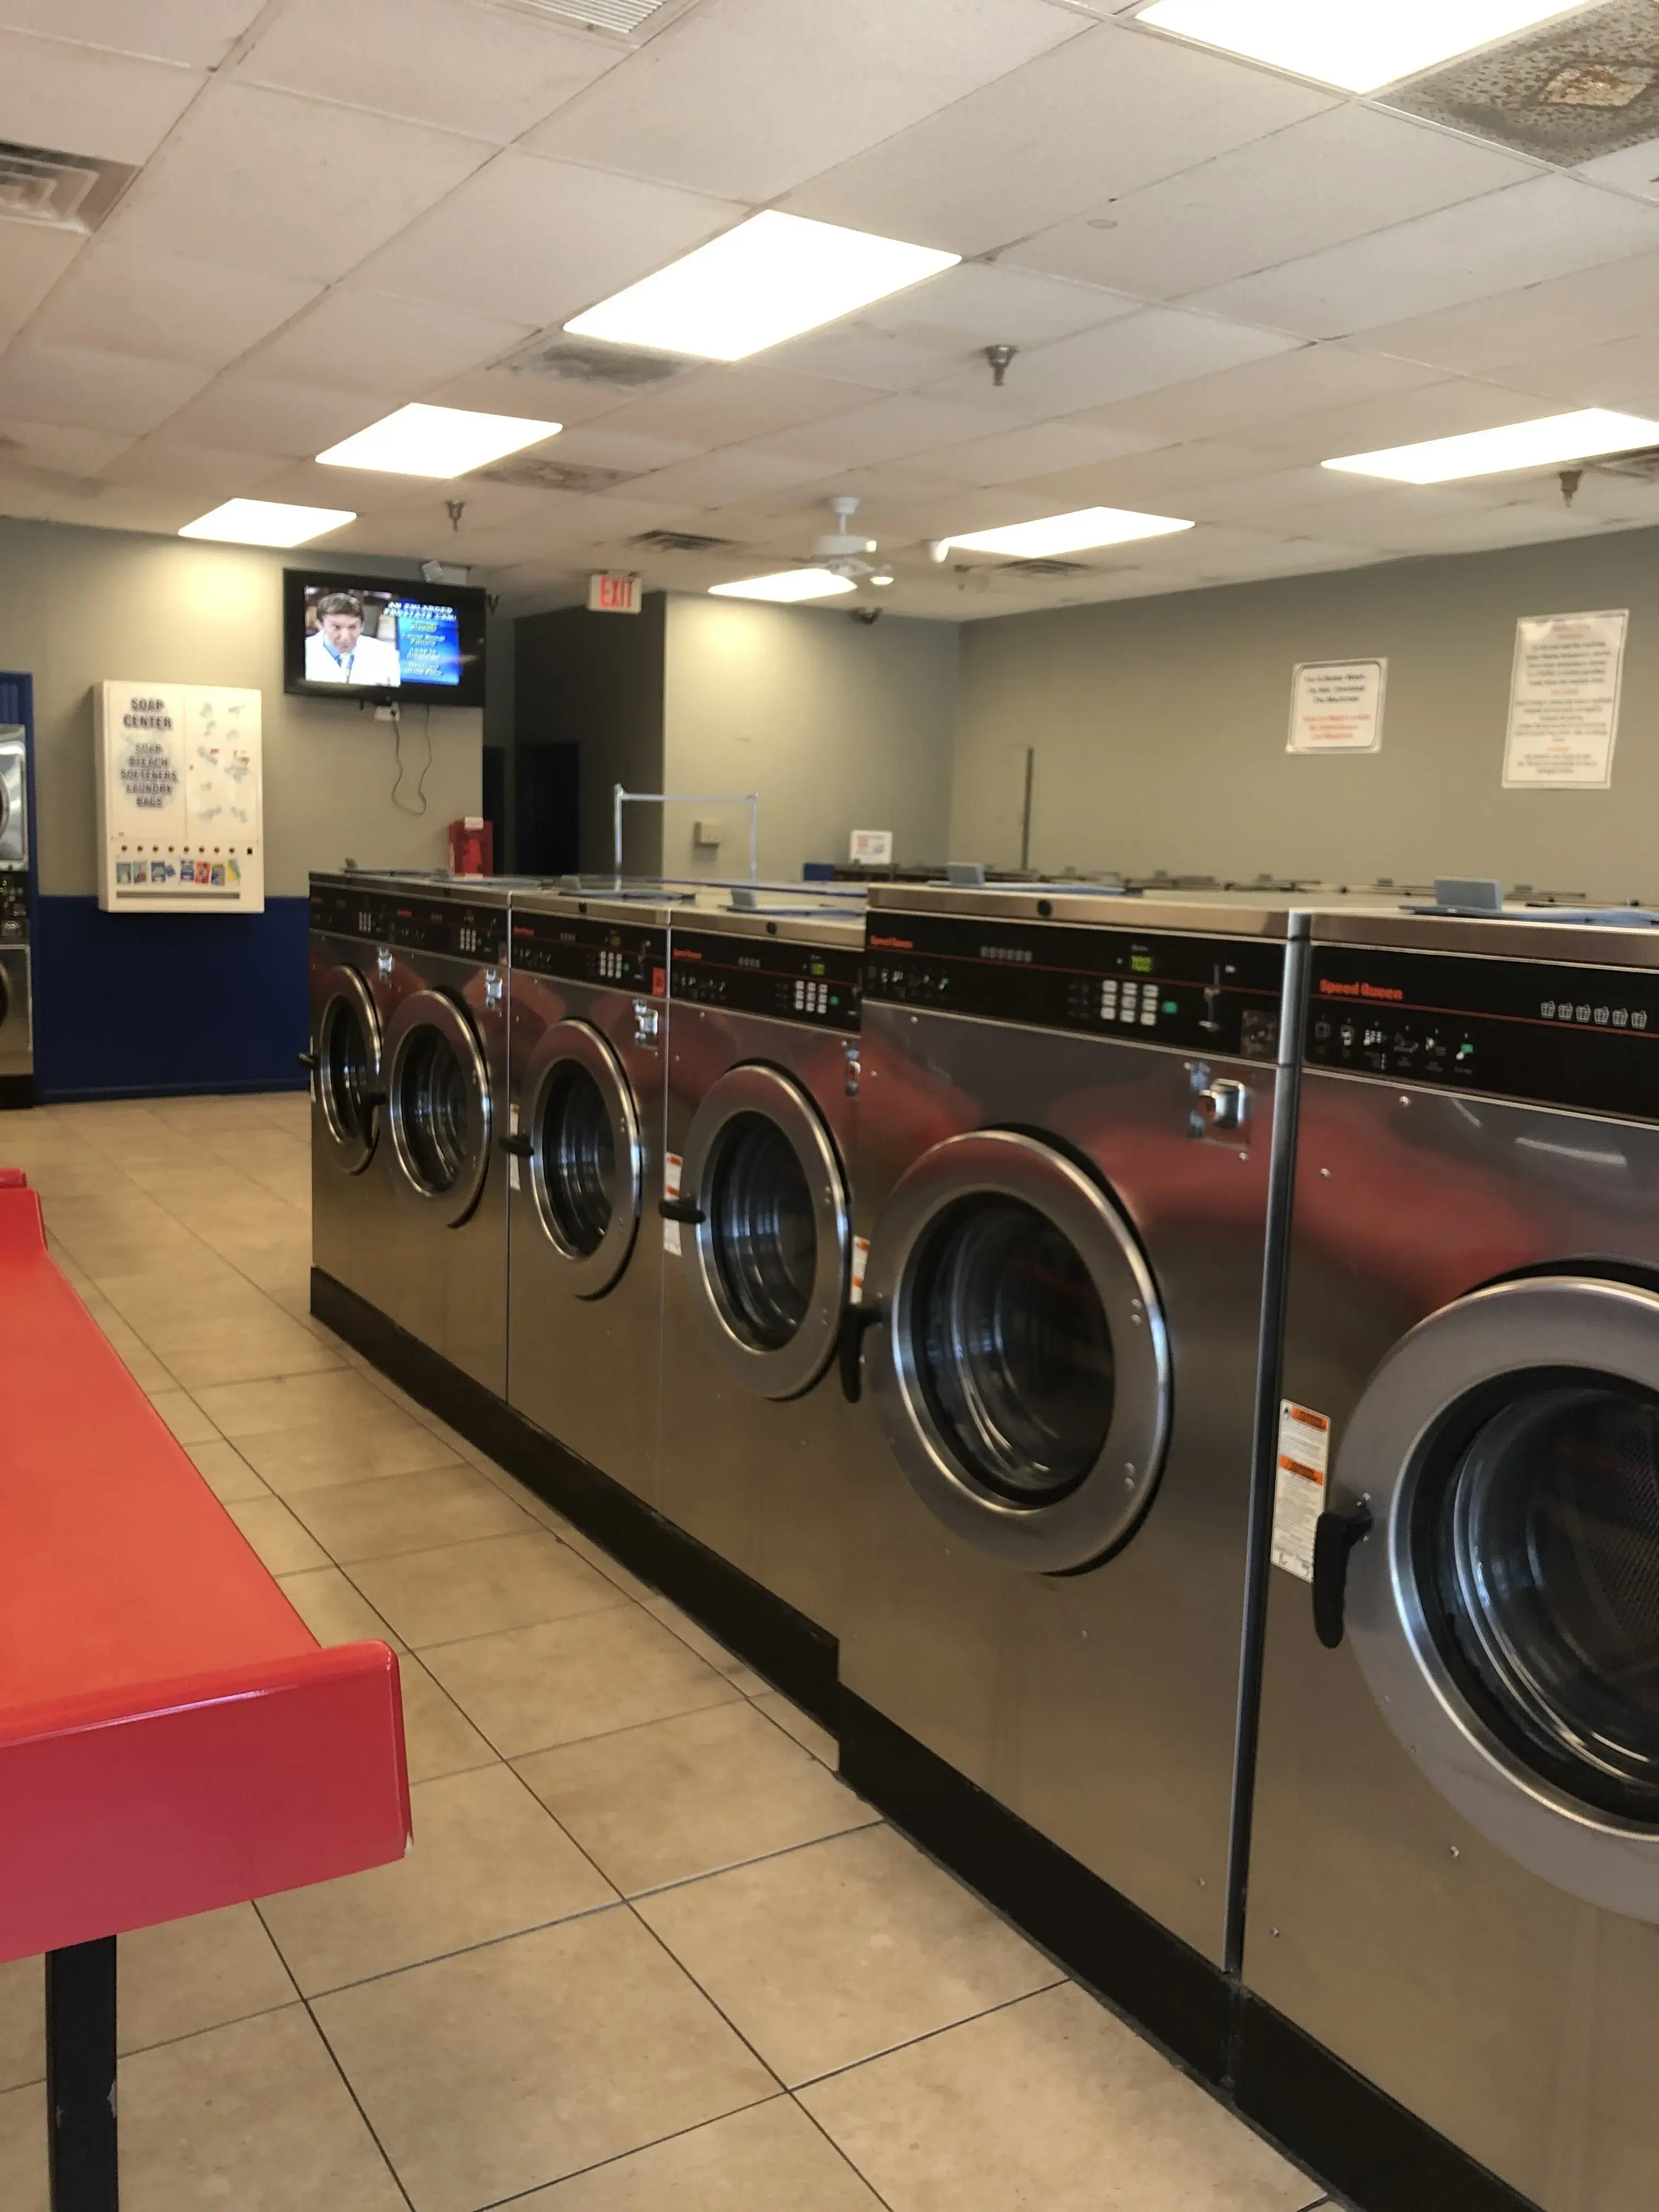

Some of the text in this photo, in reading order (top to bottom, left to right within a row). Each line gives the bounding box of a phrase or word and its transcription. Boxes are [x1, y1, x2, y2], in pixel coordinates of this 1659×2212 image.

[600, 575, 634, 608] EXIT
[383, 607, 432, 619] PROSTATE
[404, 603, 453, 613] ENLARGED
[130, 698, 165, 712] SOAP
[123, 714, 173, 730] CENTER
[135, 743, 163, 754] SOAP
[128, 755, 170, 767] BLEACH
[120, 769, 178, 783] SOFTENERS
[126, 783, 172, 795] LAUNDRY
[136, 797, 163, 808] BAGS
[1319, 979, 1403, 1000] Speed Queen
